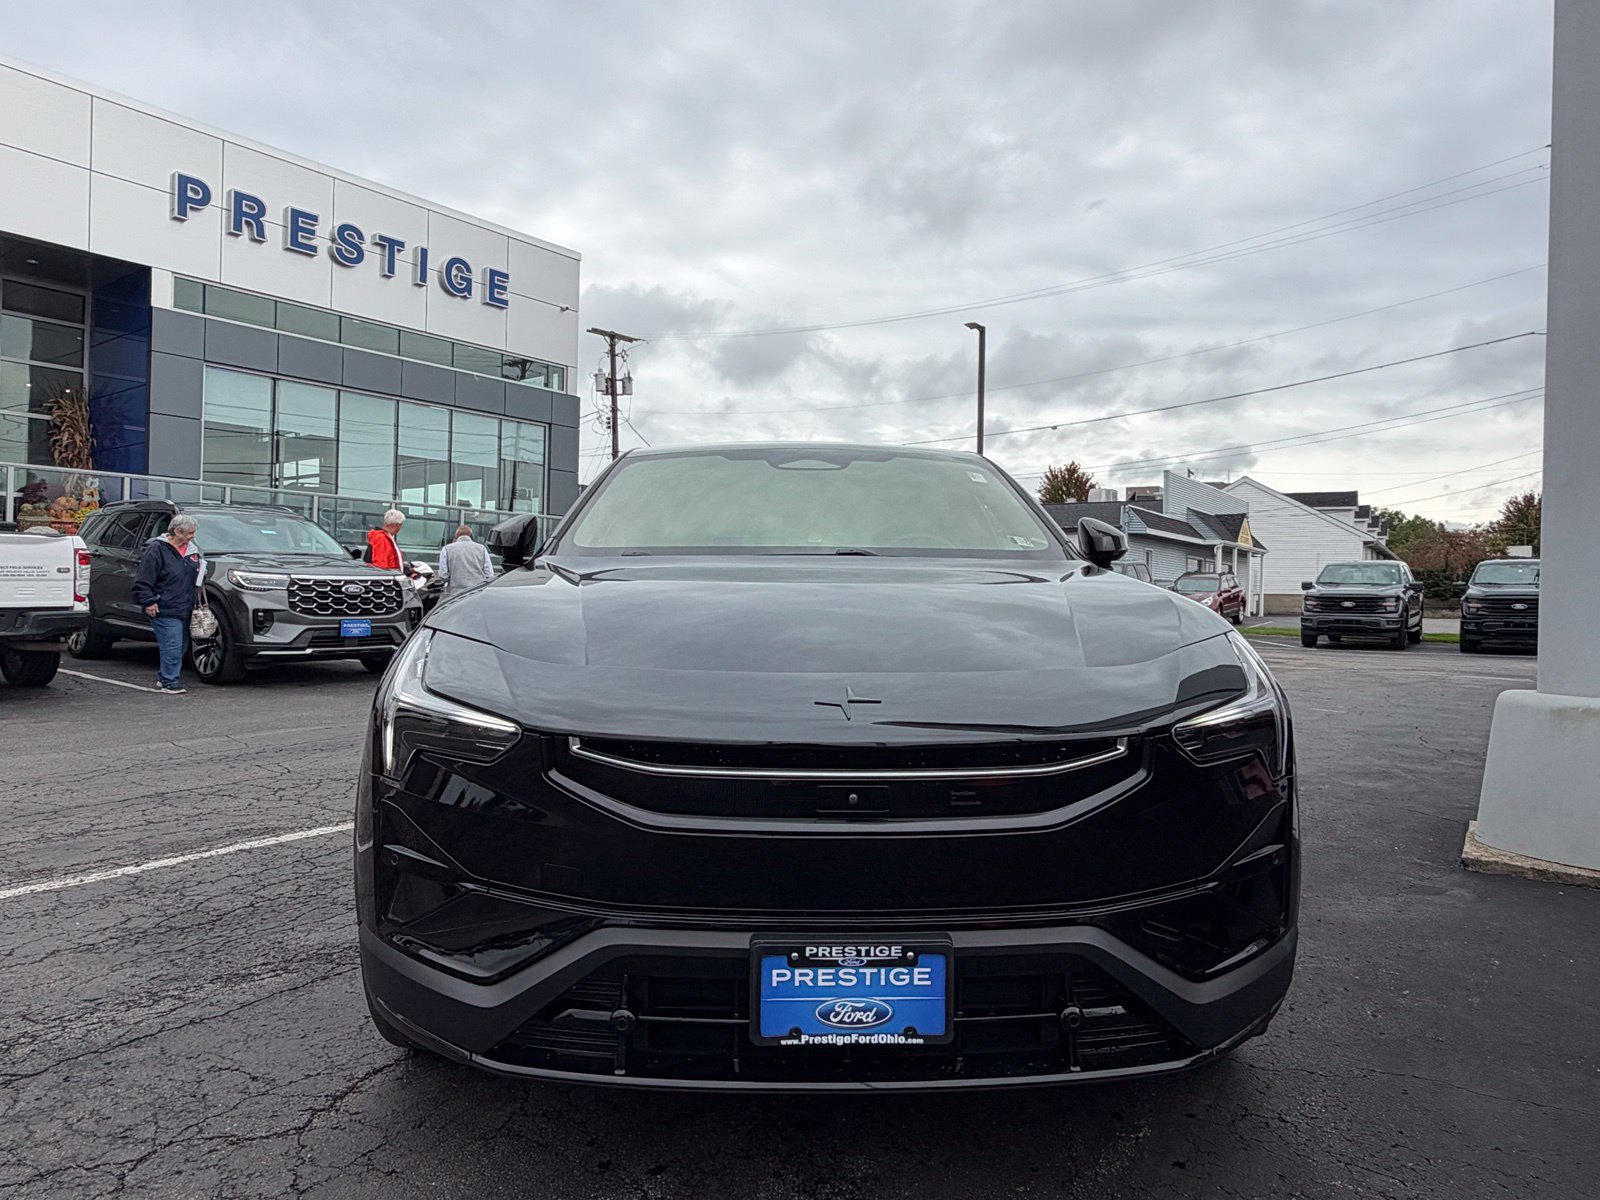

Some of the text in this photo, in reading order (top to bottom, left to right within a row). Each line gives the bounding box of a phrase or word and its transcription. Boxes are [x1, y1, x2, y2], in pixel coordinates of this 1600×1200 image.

[170, 170, 510, 310] PRESTIGE
[805, 945, 903, 957] PRESTIGE
[771, 967, 932, 987] PRESTIGE
[829, 1001, 877, 1024] Ford
[780, 1033, 924, 1046] www.PrestigeFordOhio.com
